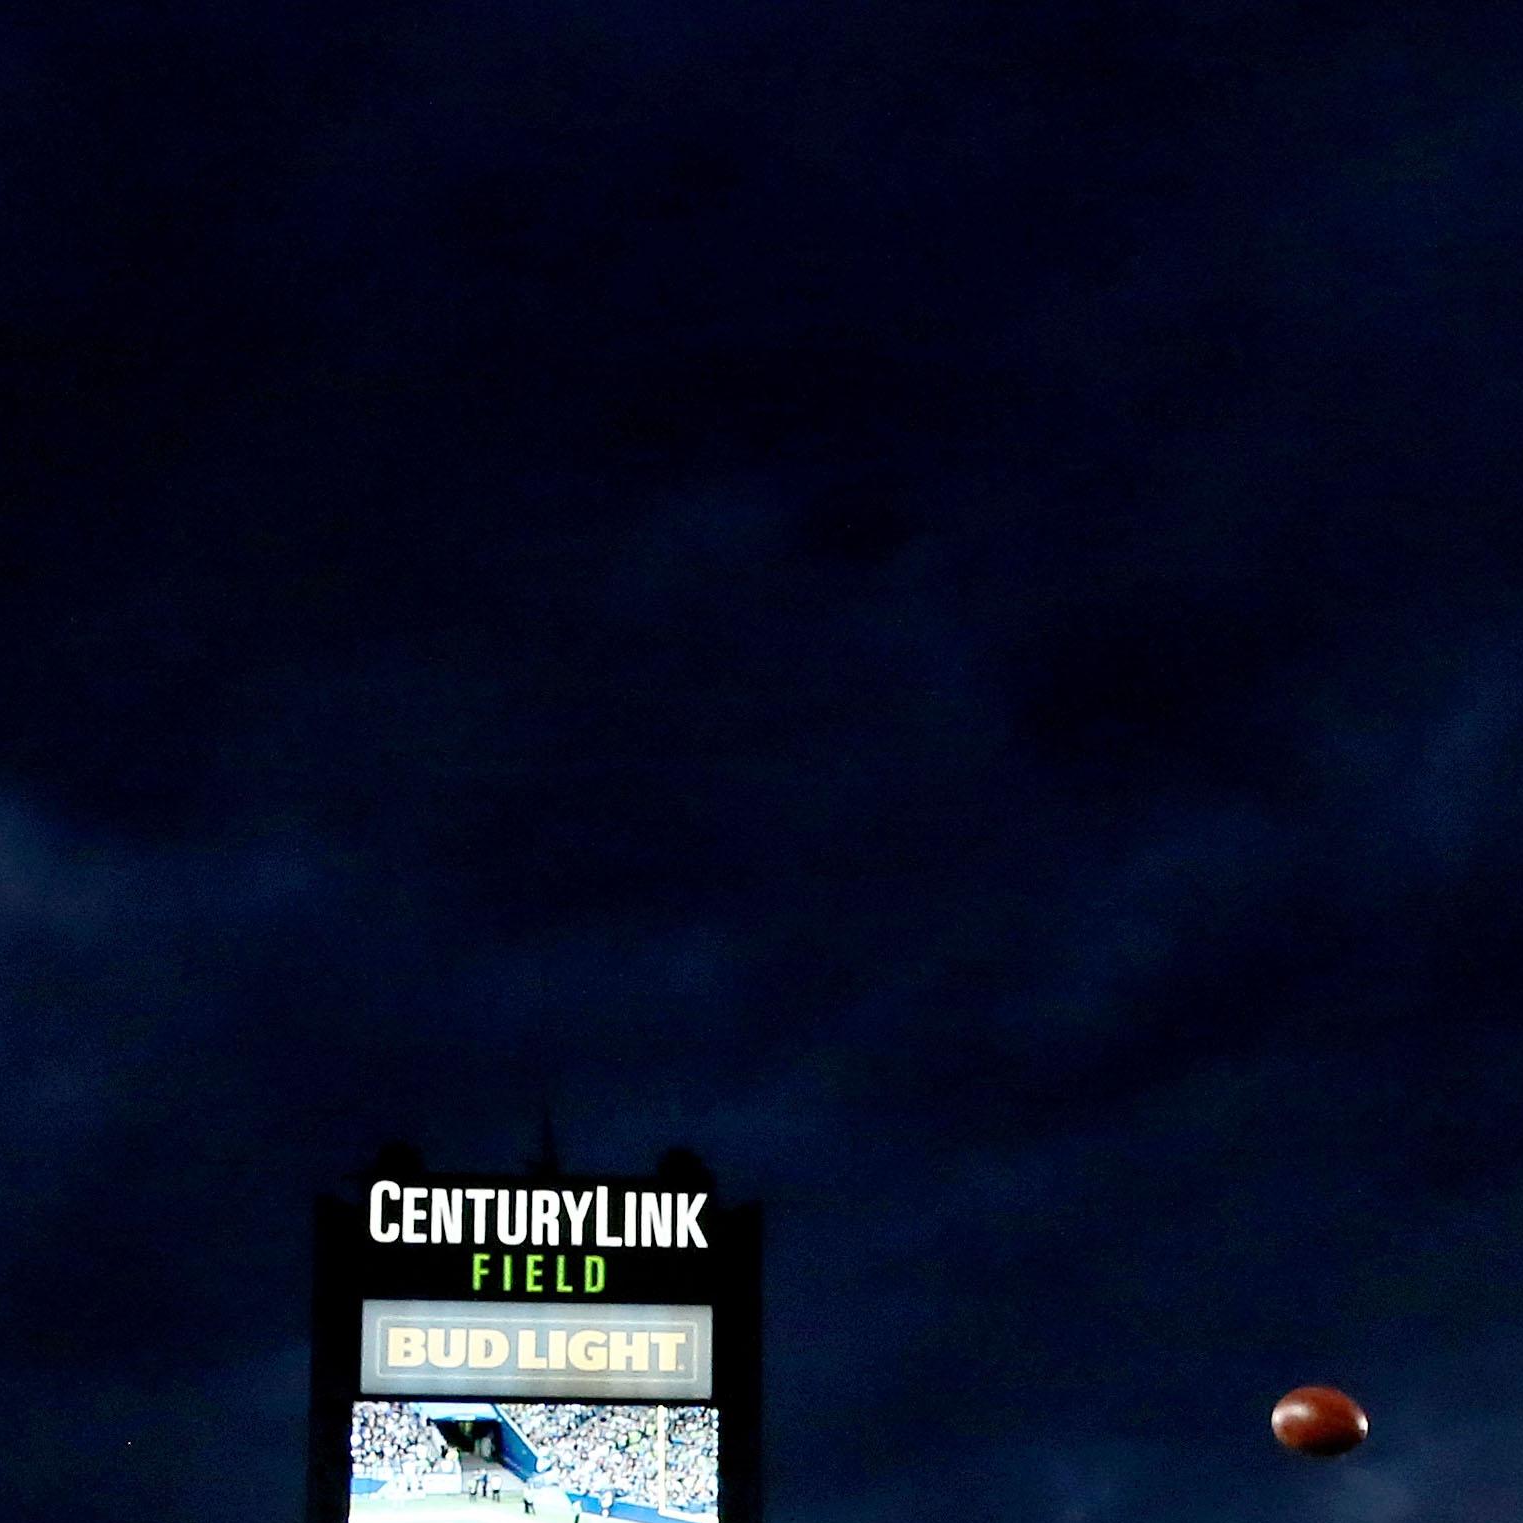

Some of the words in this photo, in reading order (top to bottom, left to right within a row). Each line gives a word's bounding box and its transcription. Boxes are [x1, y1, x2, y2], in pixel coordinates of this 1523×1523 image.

[369, 1180, 708, 1249] CENTURYLINK
[473, 1253, 605, 1293] FIELD
[387, 1326, 510, 1368] BUD
[518, 1329, 686, 1372] LIGHT
